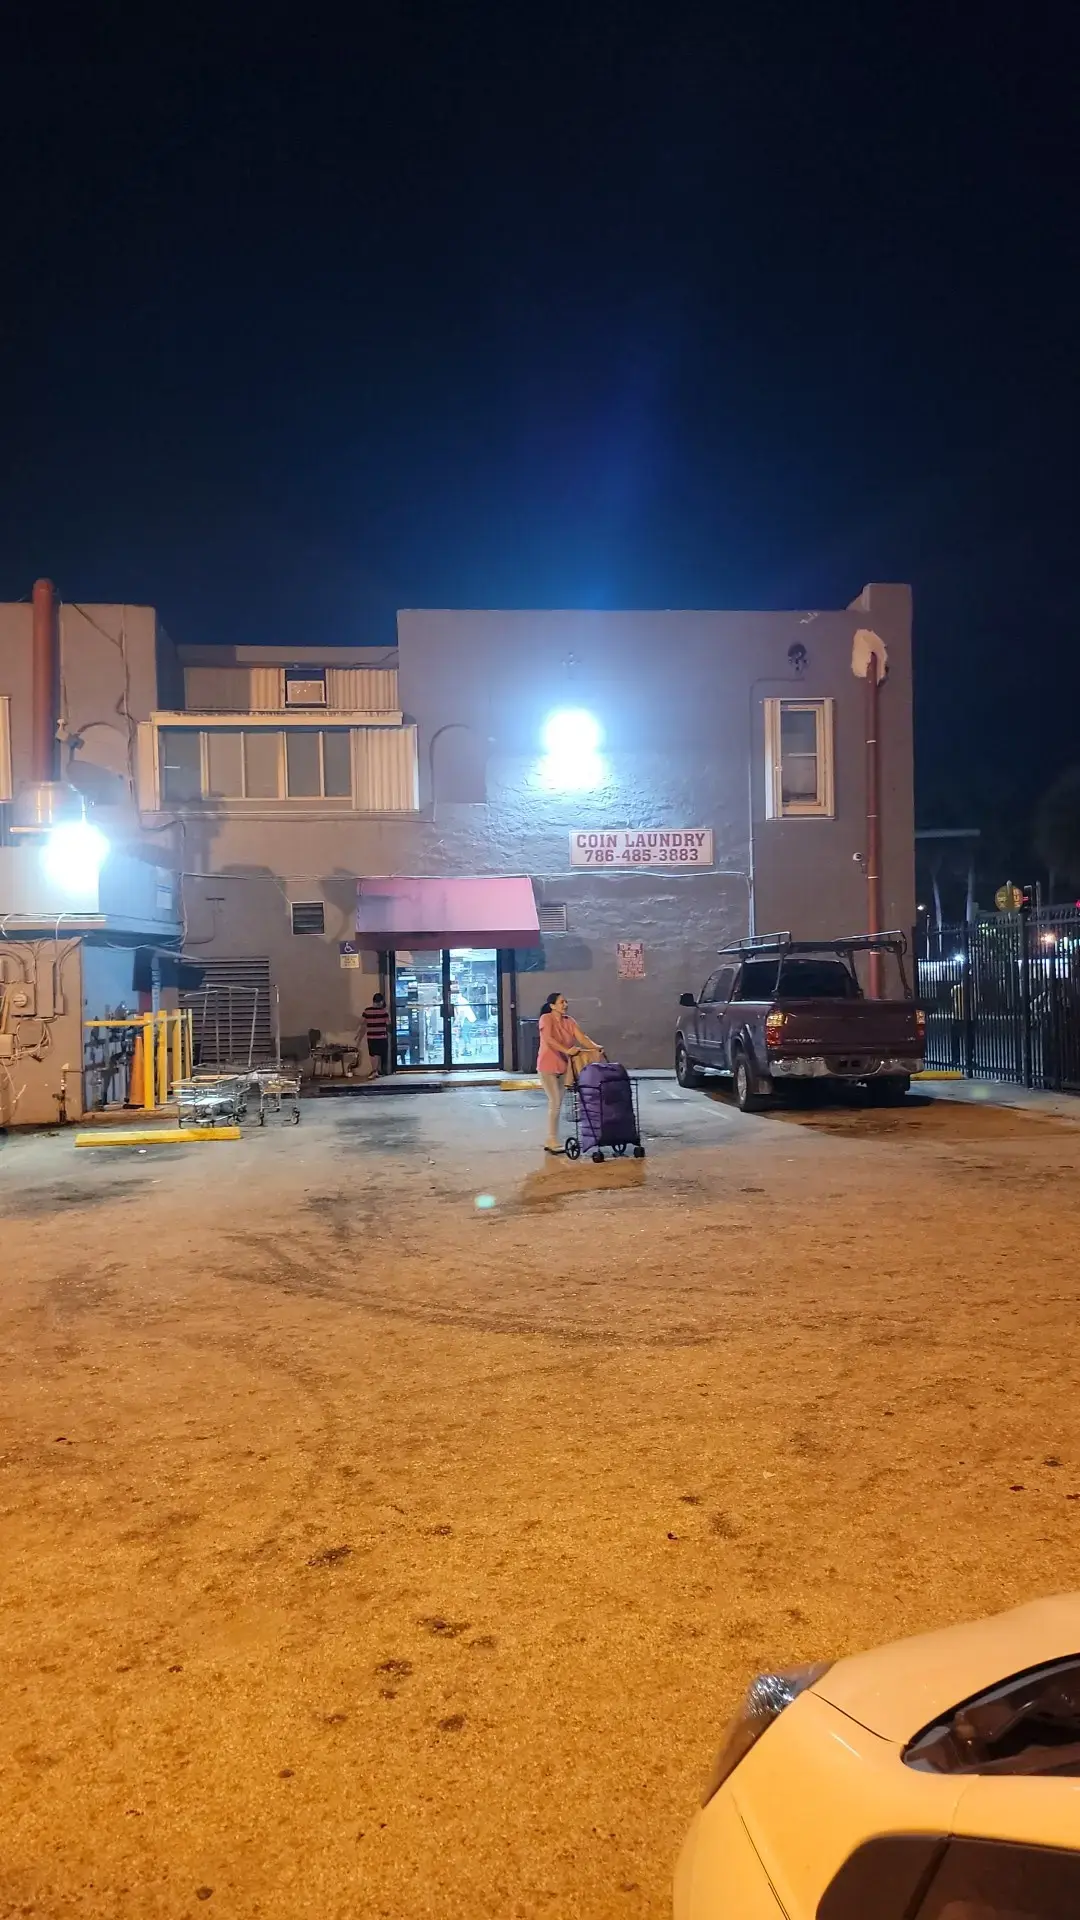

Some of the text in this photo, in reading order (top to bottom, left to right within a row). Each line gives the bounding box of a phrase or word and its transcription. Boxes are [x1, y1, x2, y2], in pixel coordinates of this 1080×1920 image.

[576, 833, 705, 848] COIN LAUNDRY
[585, 849, 698, 862] 786-485-3883
